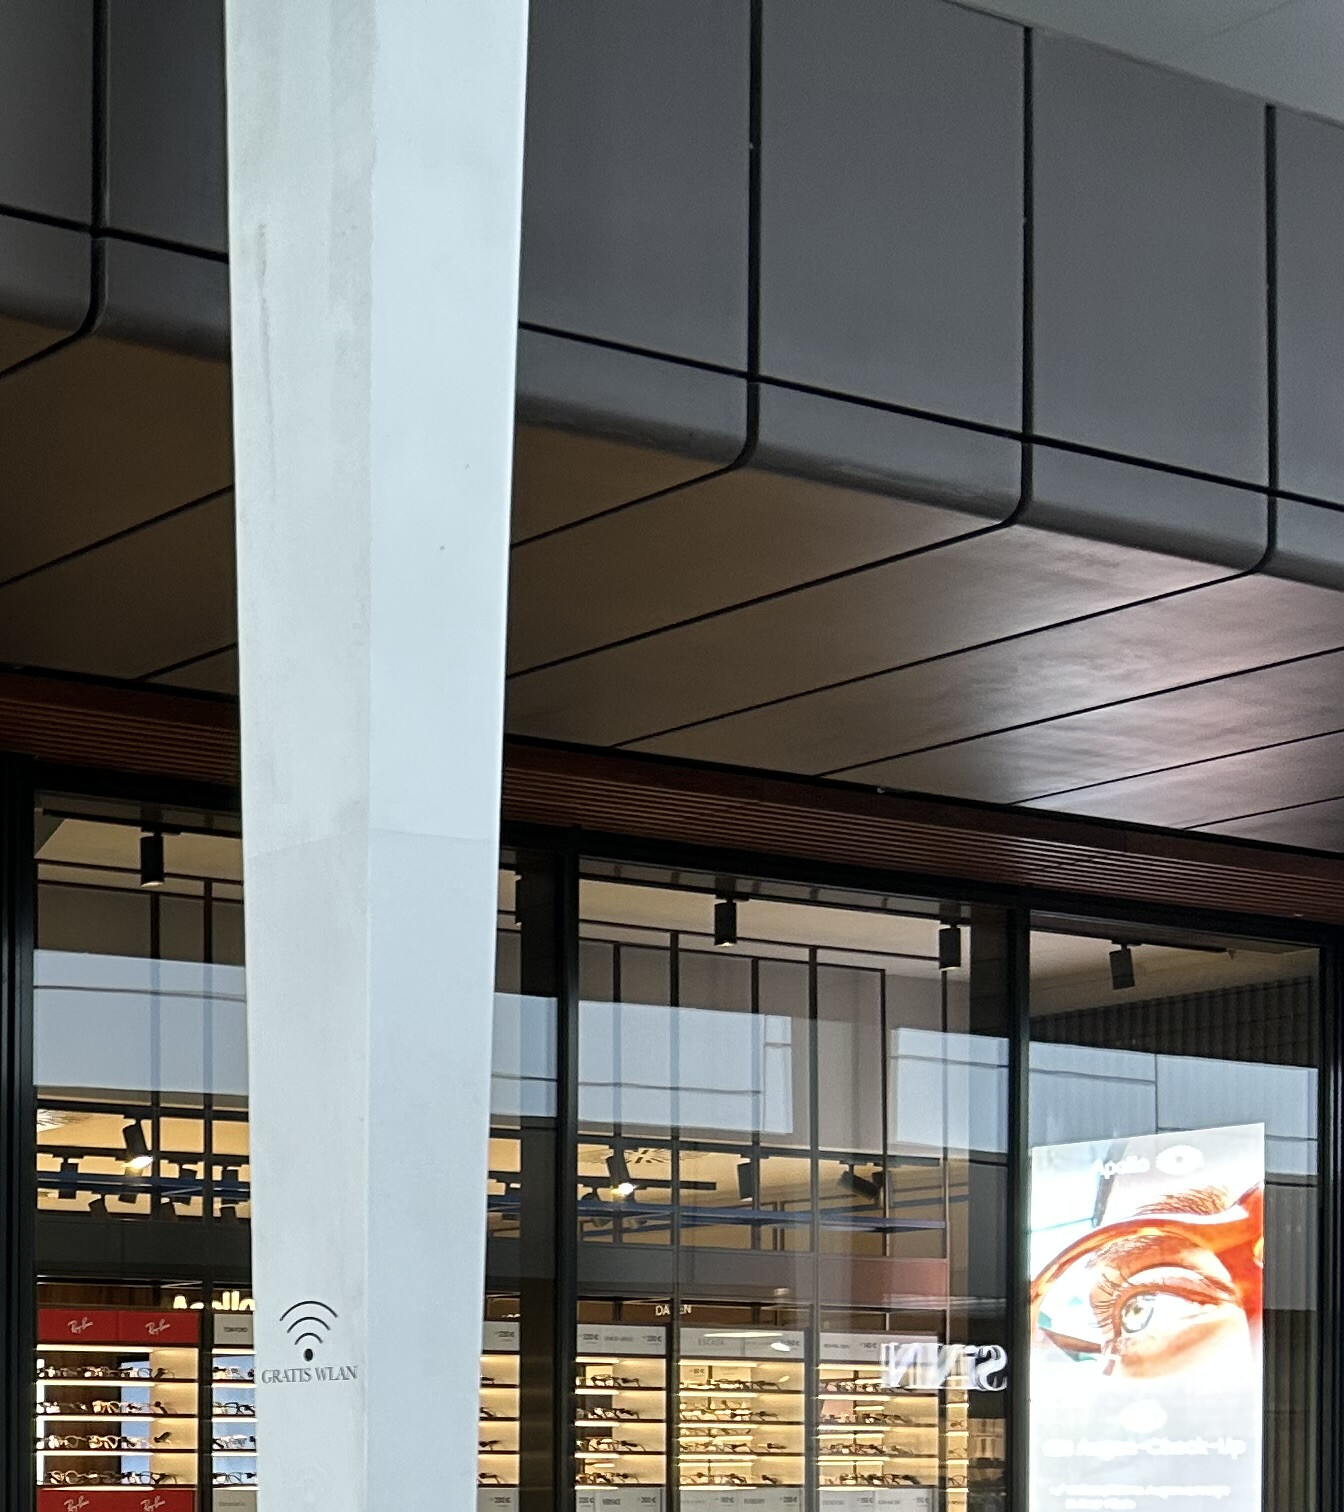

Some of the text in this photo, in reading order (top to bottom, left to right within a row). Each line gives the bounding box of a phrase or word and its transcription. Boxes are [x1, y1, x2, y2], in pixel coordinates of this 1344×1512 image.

[655, 1304, 692, 1316] DAEN
[261, 1365, 359, 1384] GRATIS WLAN
